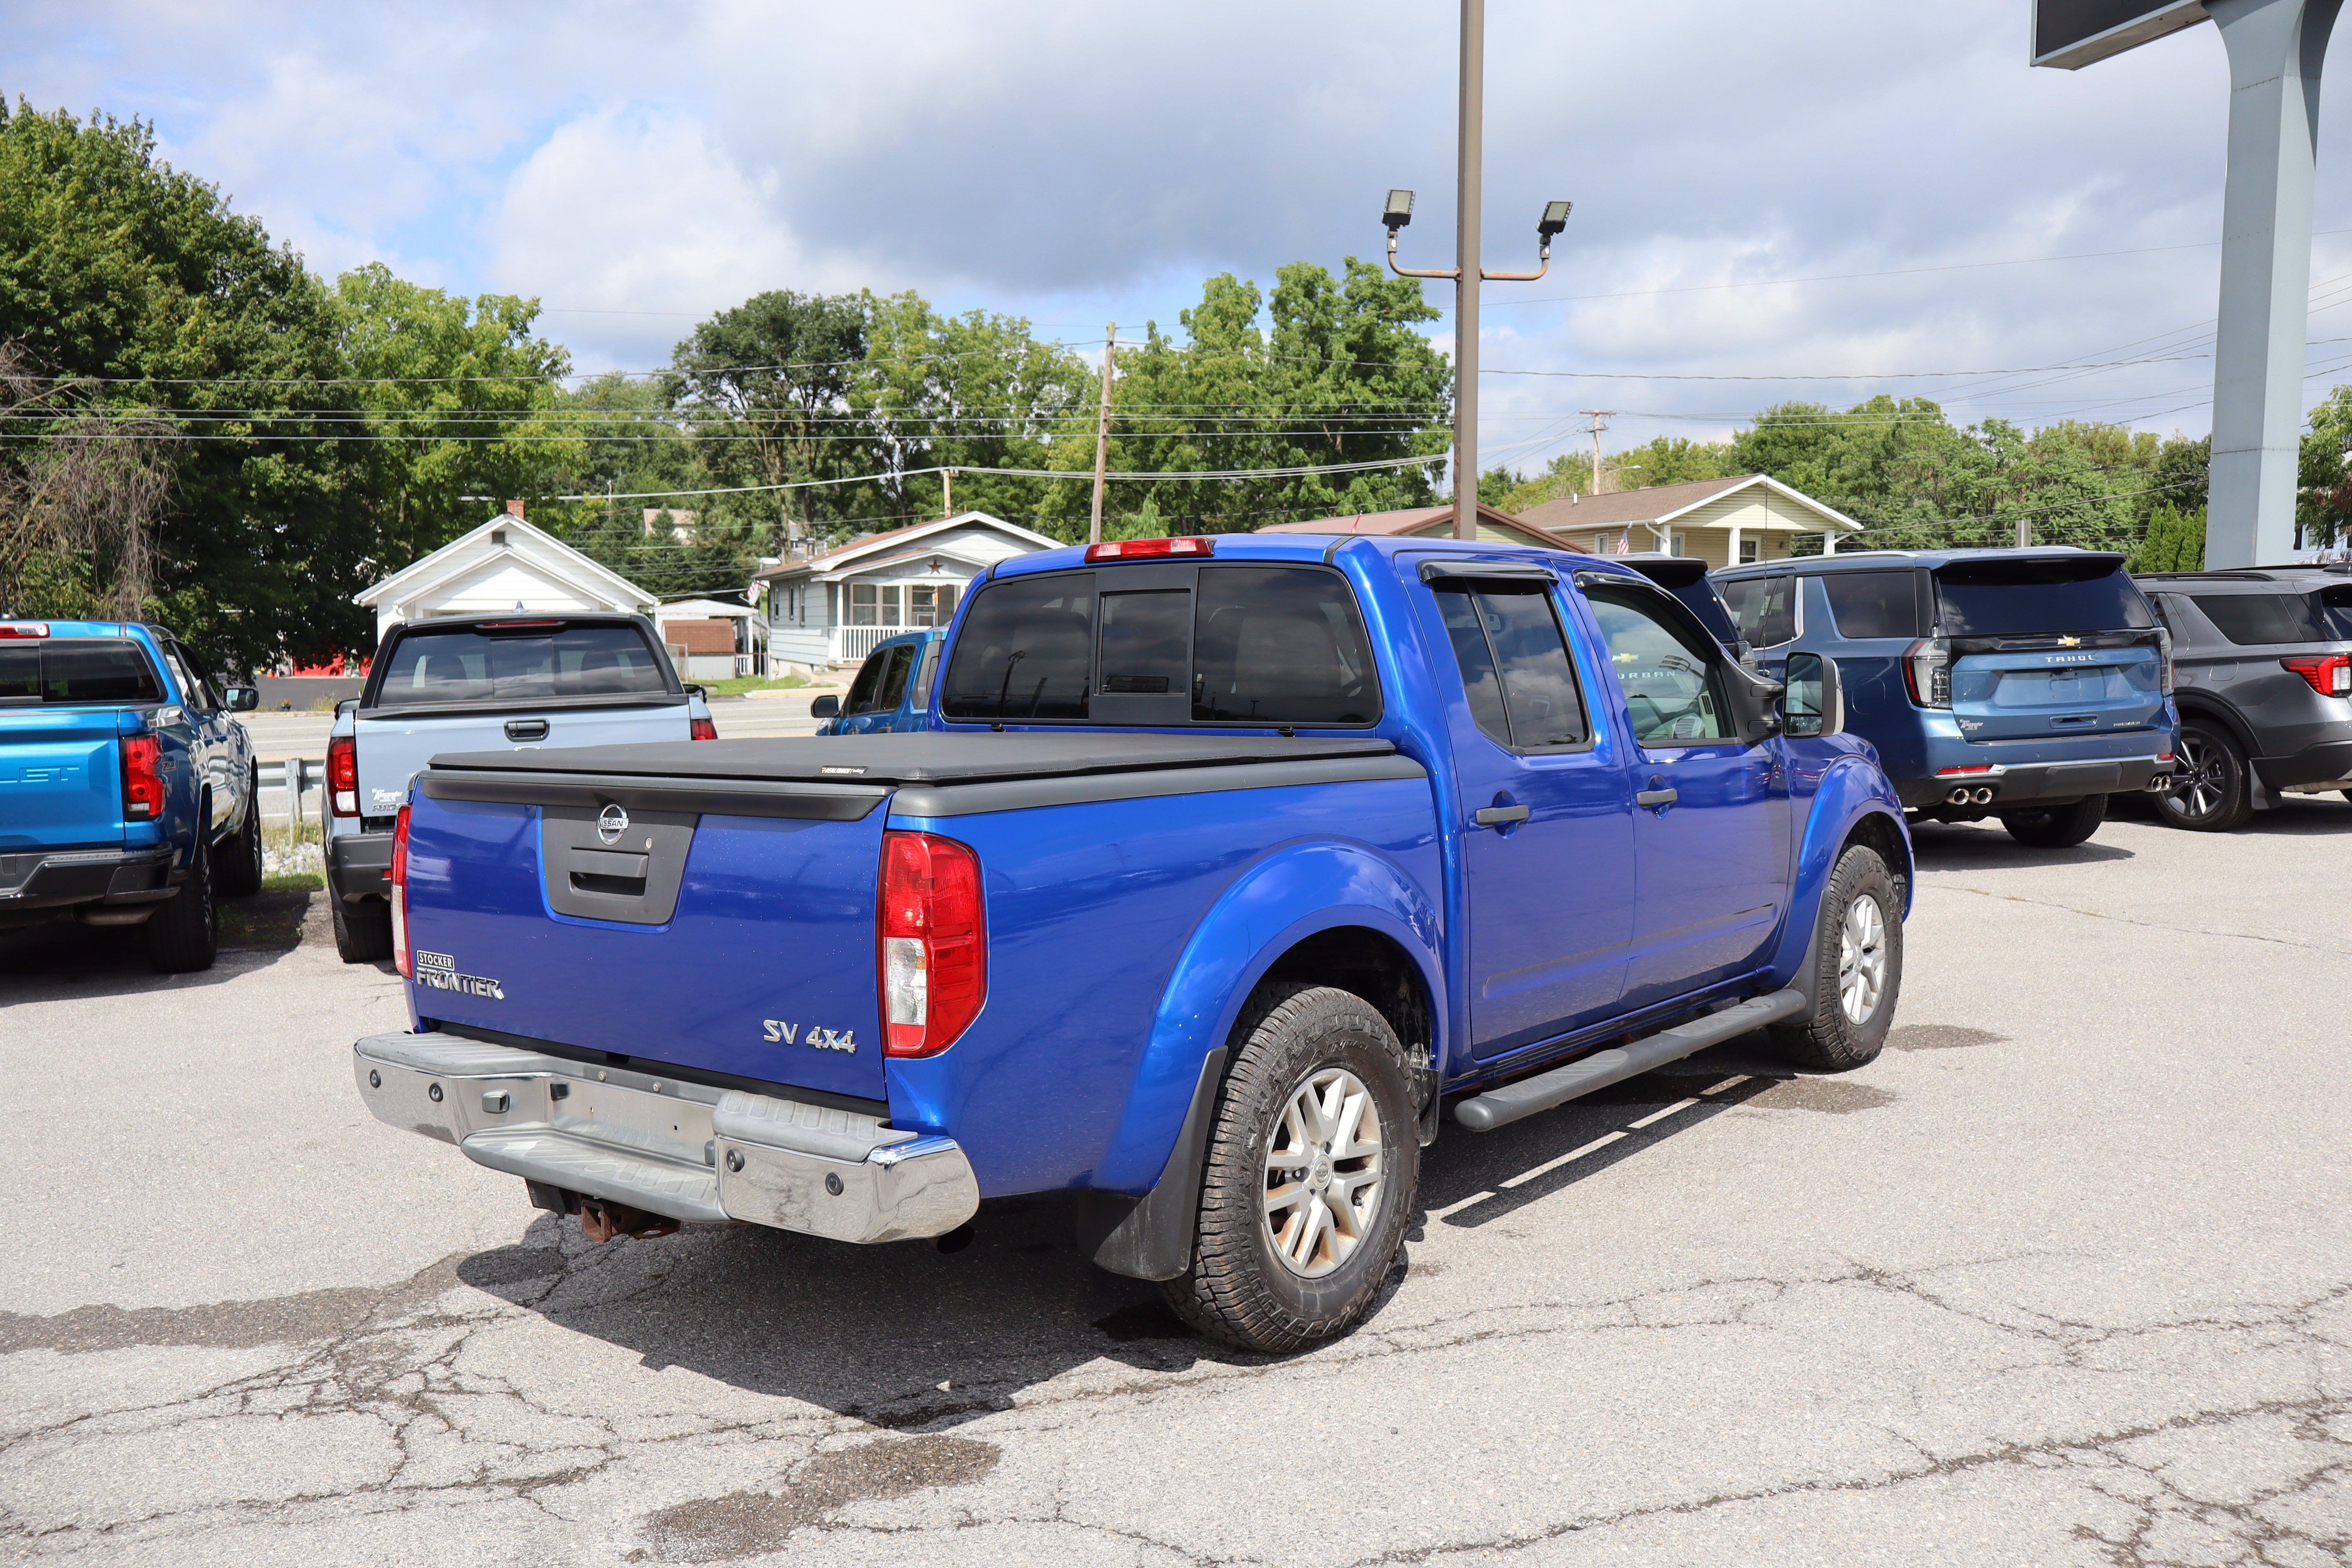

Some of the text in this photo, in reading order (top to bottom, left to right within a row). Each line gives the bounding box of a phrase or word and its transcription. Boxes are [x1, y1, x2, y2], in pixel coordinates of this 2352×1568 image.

[373, 791, 403, 801] Alexander
[597, 819, 623, 828] NISSAN
[419, 953, 452, 968] STOCKER
[416, 966, 504, 1000] FRONTIER
[763, 1019, 799, 1045] SV
